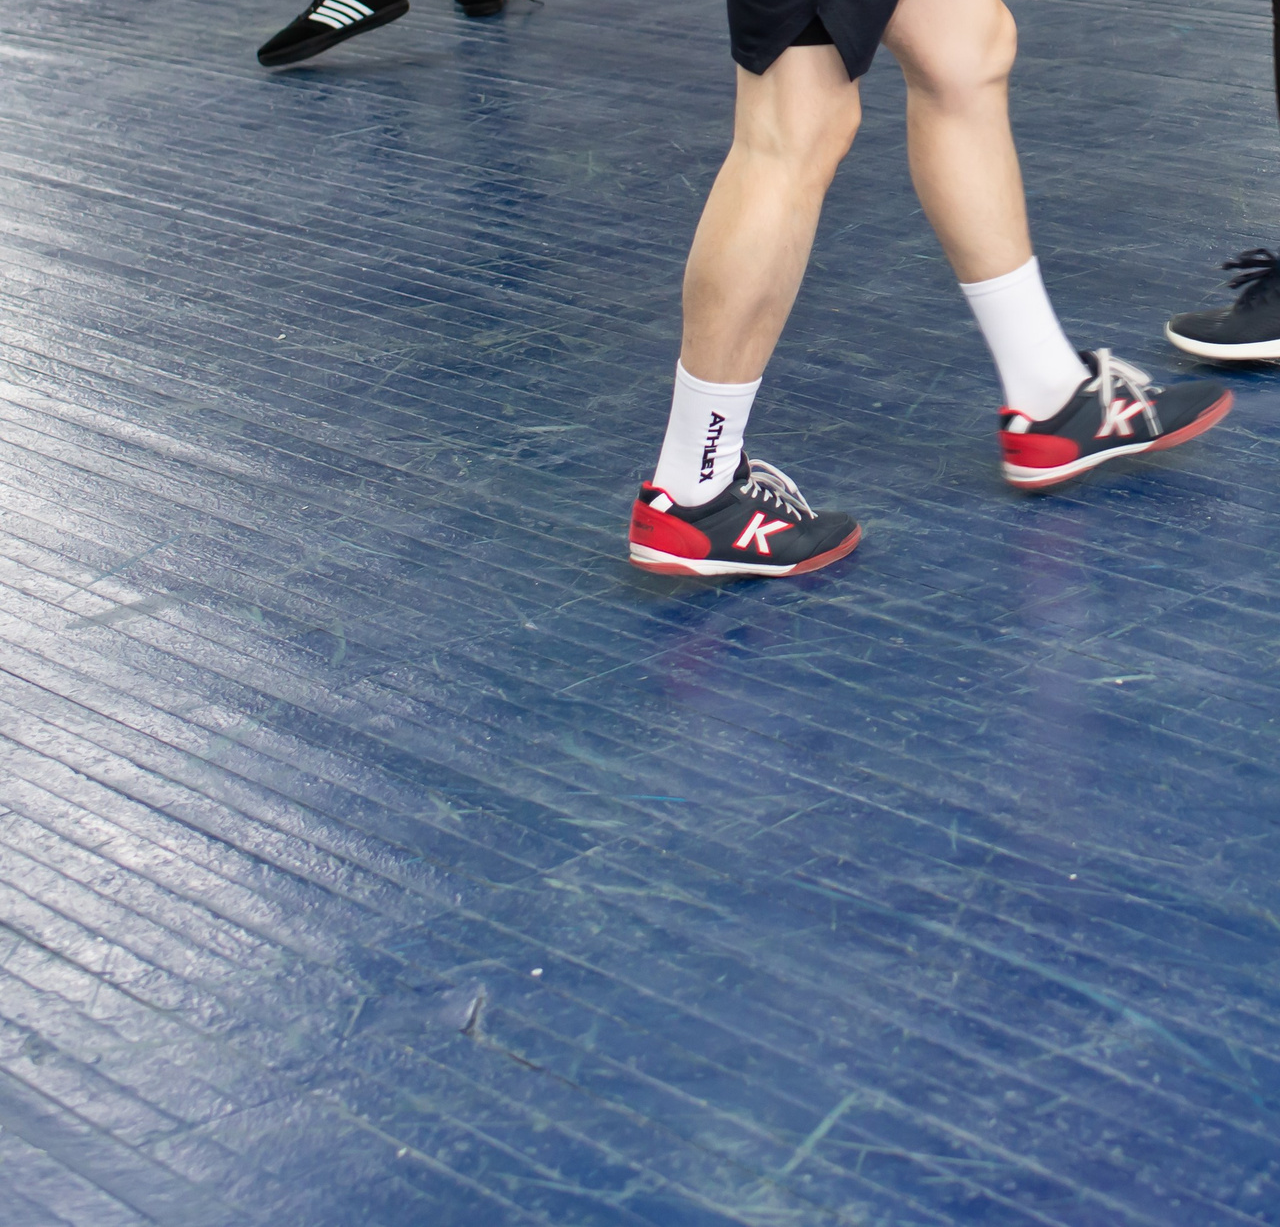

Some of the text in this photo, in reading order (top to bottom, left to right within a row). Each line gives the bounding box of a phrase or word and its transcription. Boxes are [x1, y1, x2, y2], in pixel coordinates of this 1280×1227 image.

[1093, 397, 1157, 439] K
[698, 411, 726, 484] ATHLEX
[732, 510, 795, 557] K
